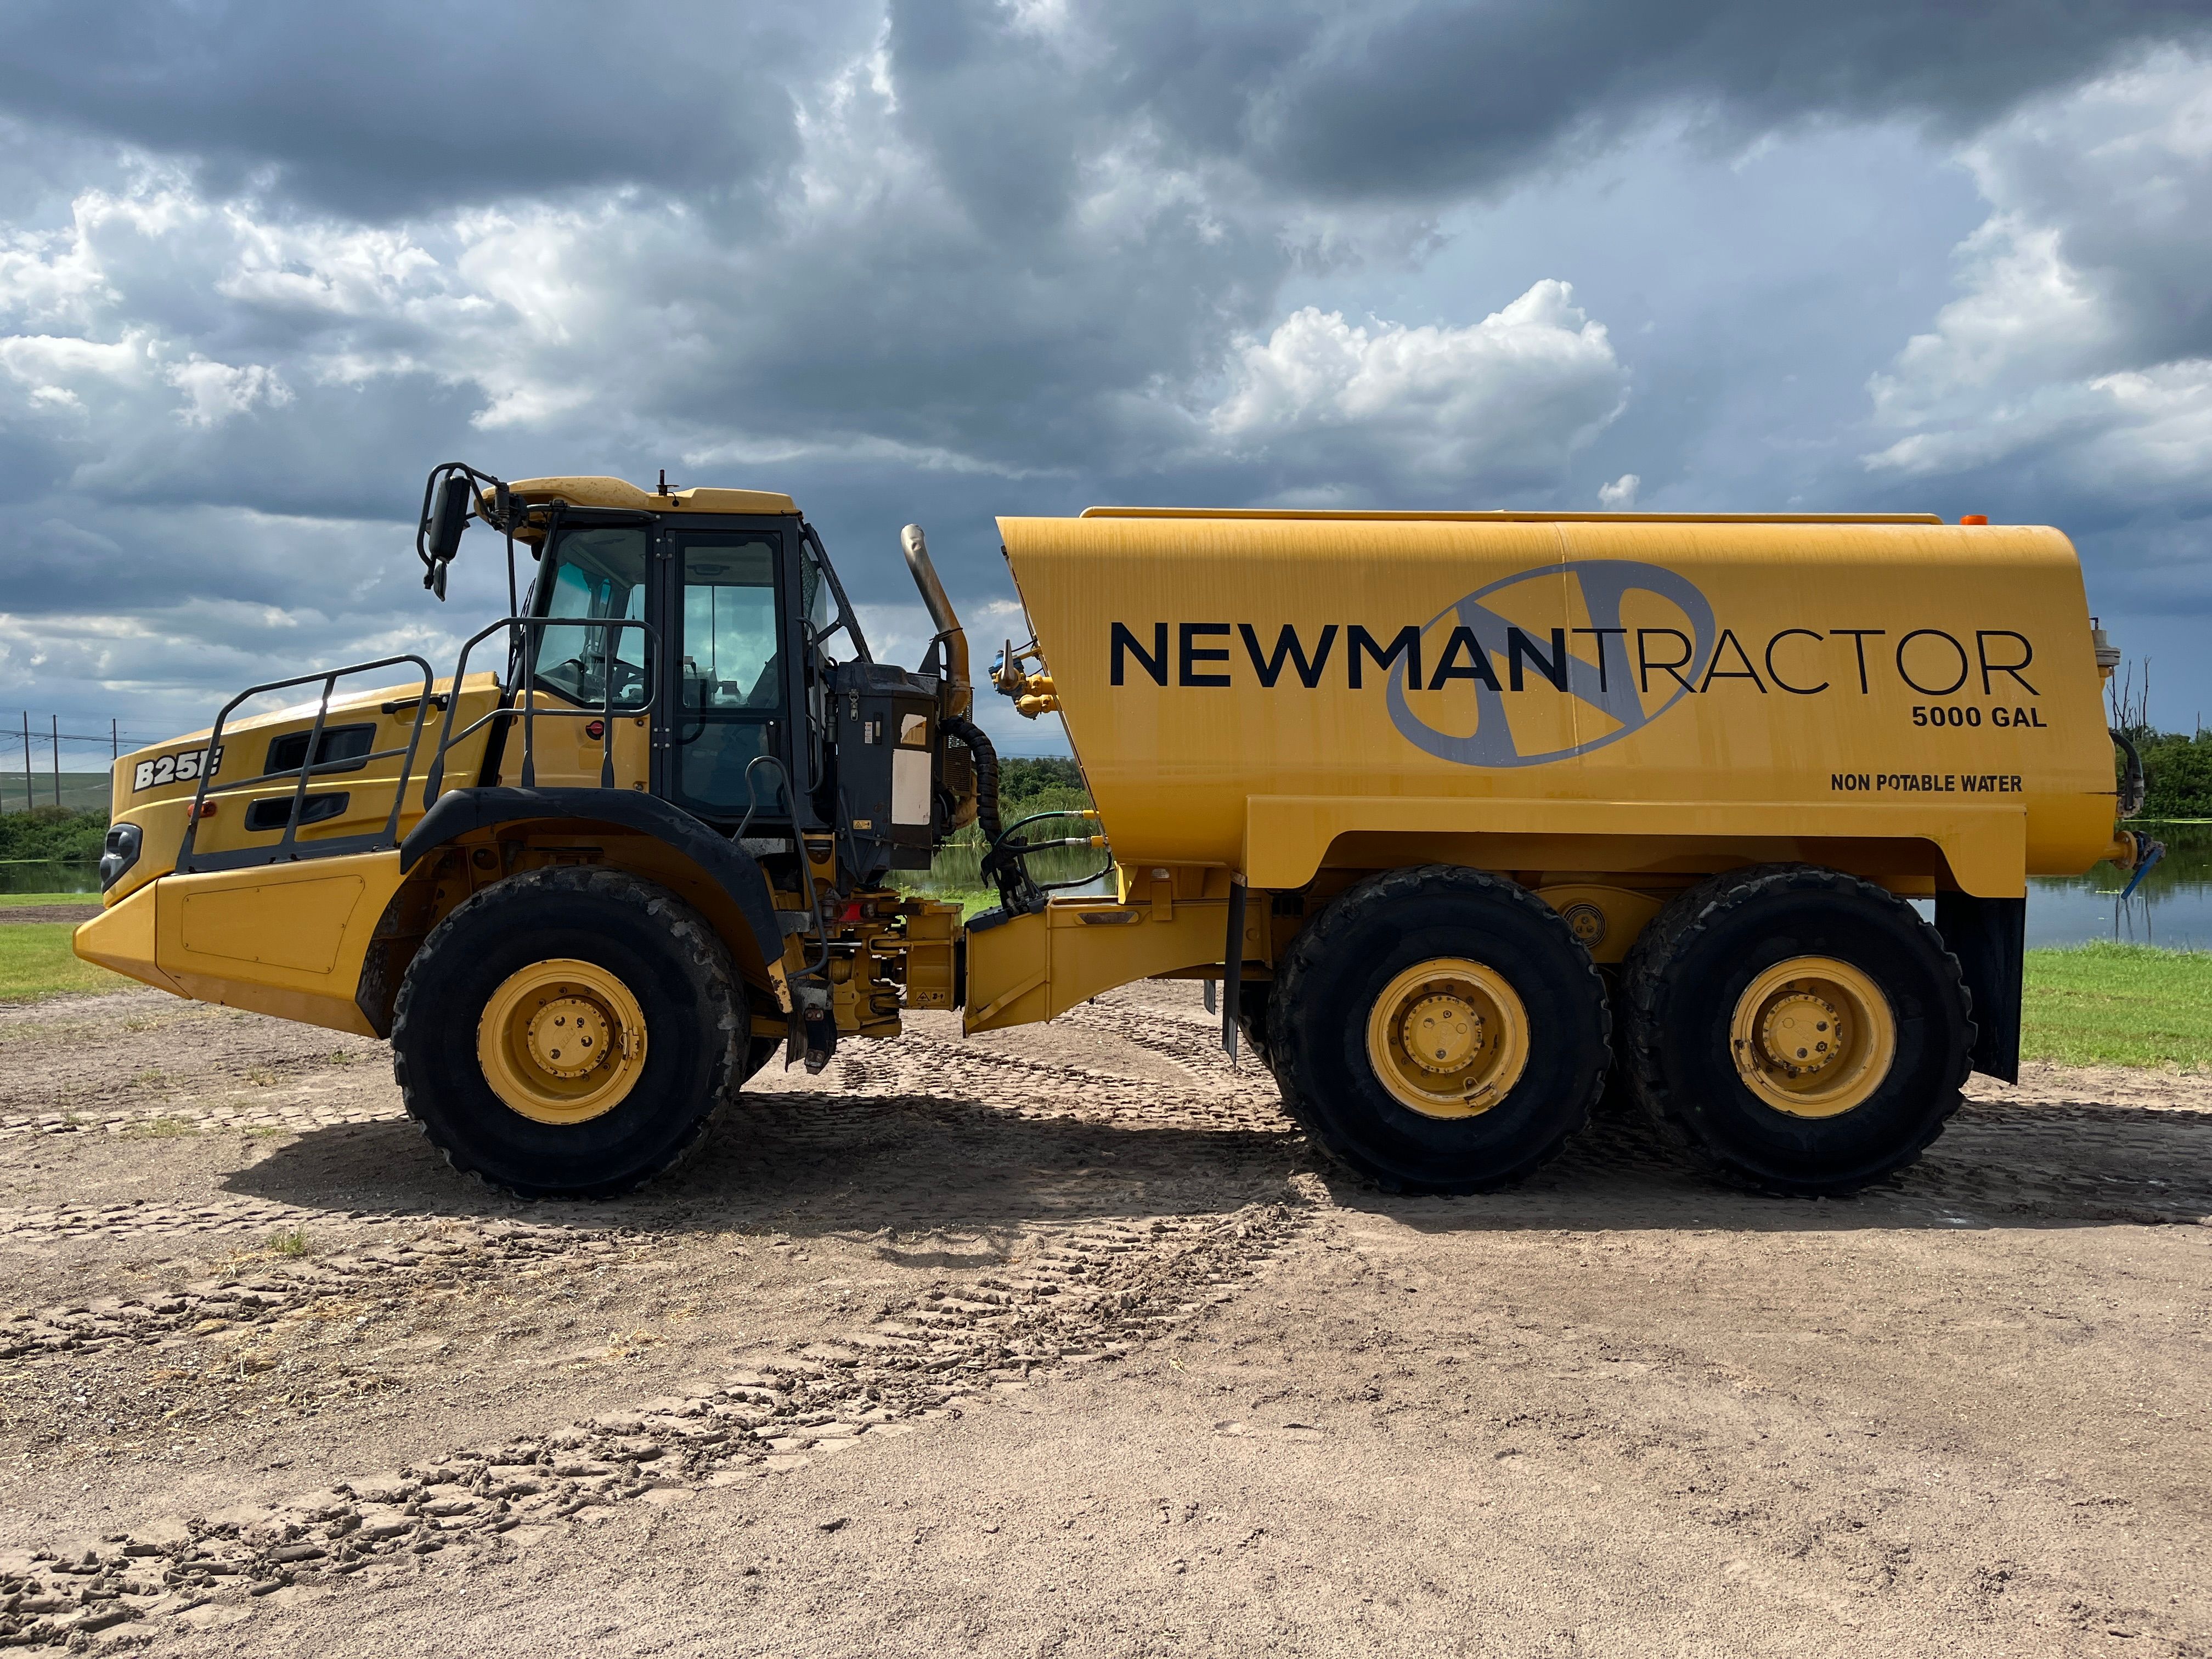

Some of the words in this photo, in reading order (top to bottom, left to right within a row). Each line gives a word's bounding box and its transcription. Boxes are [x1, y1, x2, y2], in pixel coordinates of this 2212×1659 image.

[1913, 707, 1981, 726] 5000
[1992, 707, 2047, 727] GAL
[1831, 774, 1870, 791] NON
[1877, 774, 1955, 792] POTABLE
[1961, 775, 2022, 792] WATER
